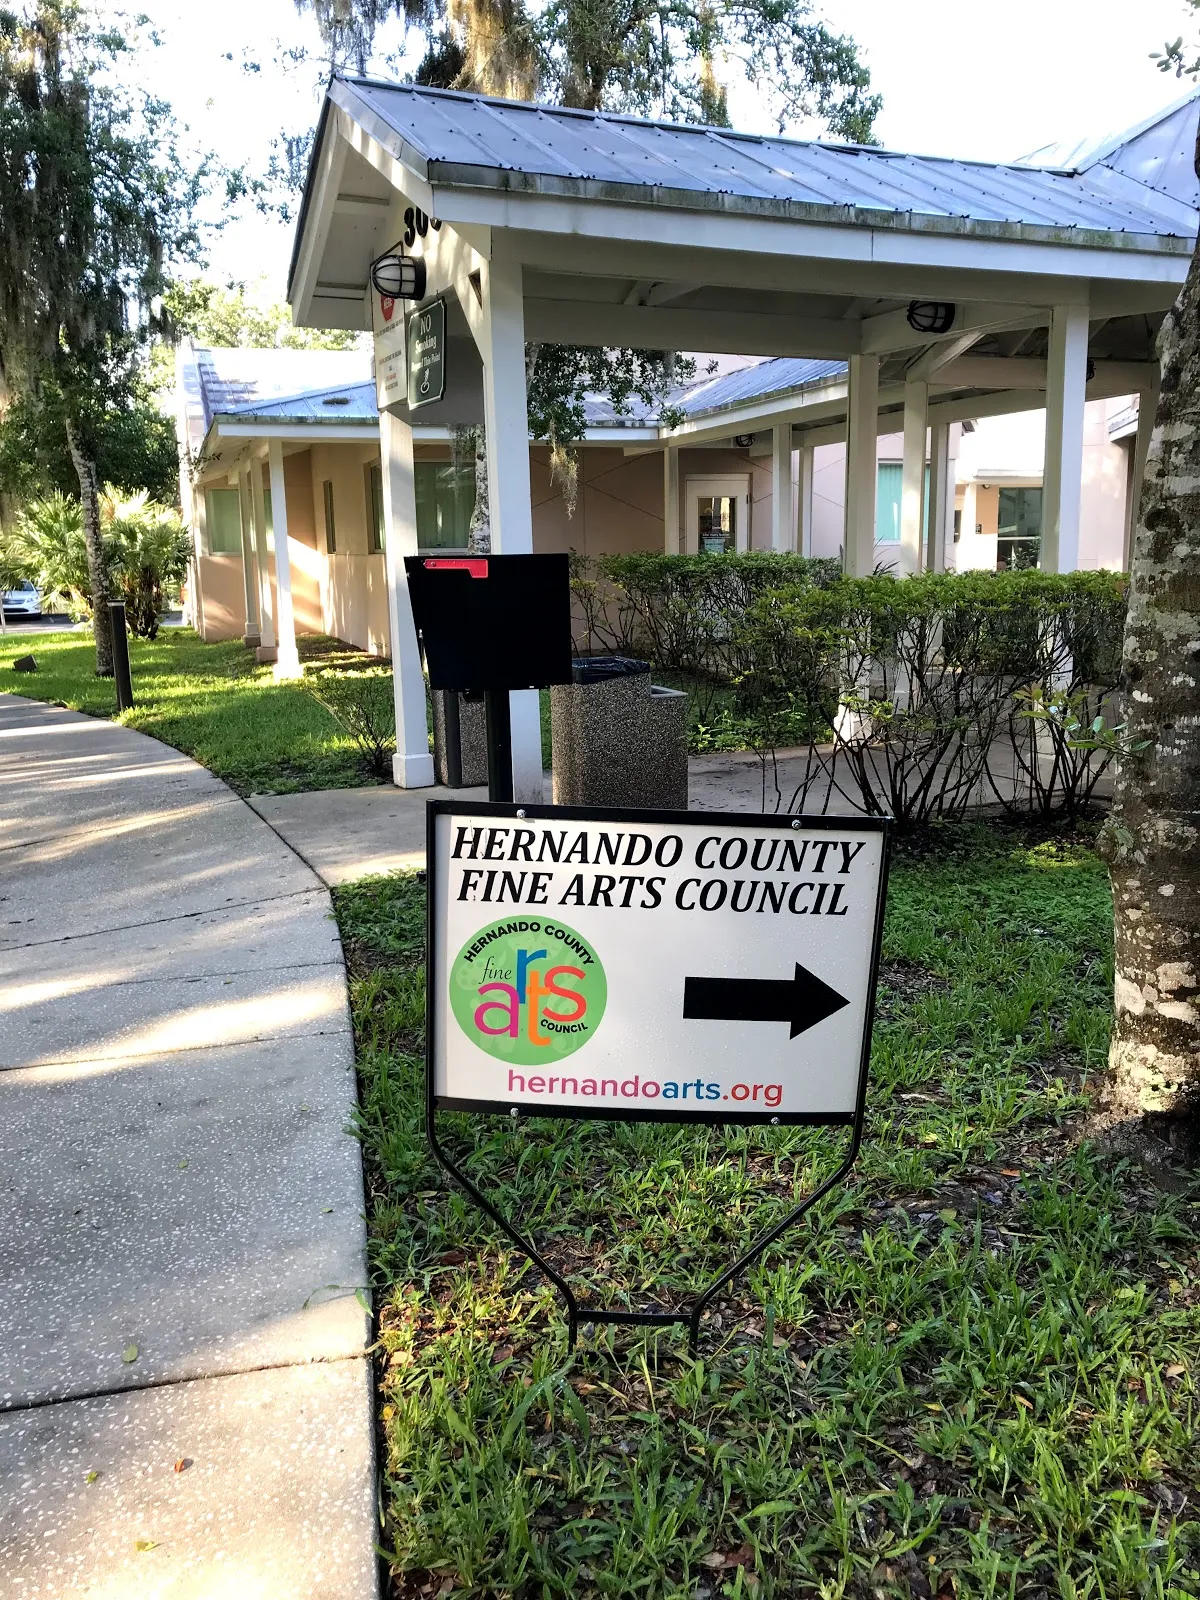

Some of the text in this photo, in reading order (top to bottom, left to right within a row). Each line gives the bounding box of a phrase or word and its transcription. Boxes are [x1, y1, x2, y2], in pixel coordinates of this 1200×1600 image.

[420, 314, 432, 335] NO
[415, 335, 437, 354] Smoking
[451, 827, 867, 874] HERNANDO COUNTY
[457, 869, 849, 916] FINE ARTS COUNCIL
[463, 921, 595, 965] HERNANDO COUNTY
[478, 956, 512, 985] fine
[474, 949, 587, 1047] arts
[540, 1018, 589, 1034] COUNCIL
[507, 1069, 783, 1107] hernandoarts.org
